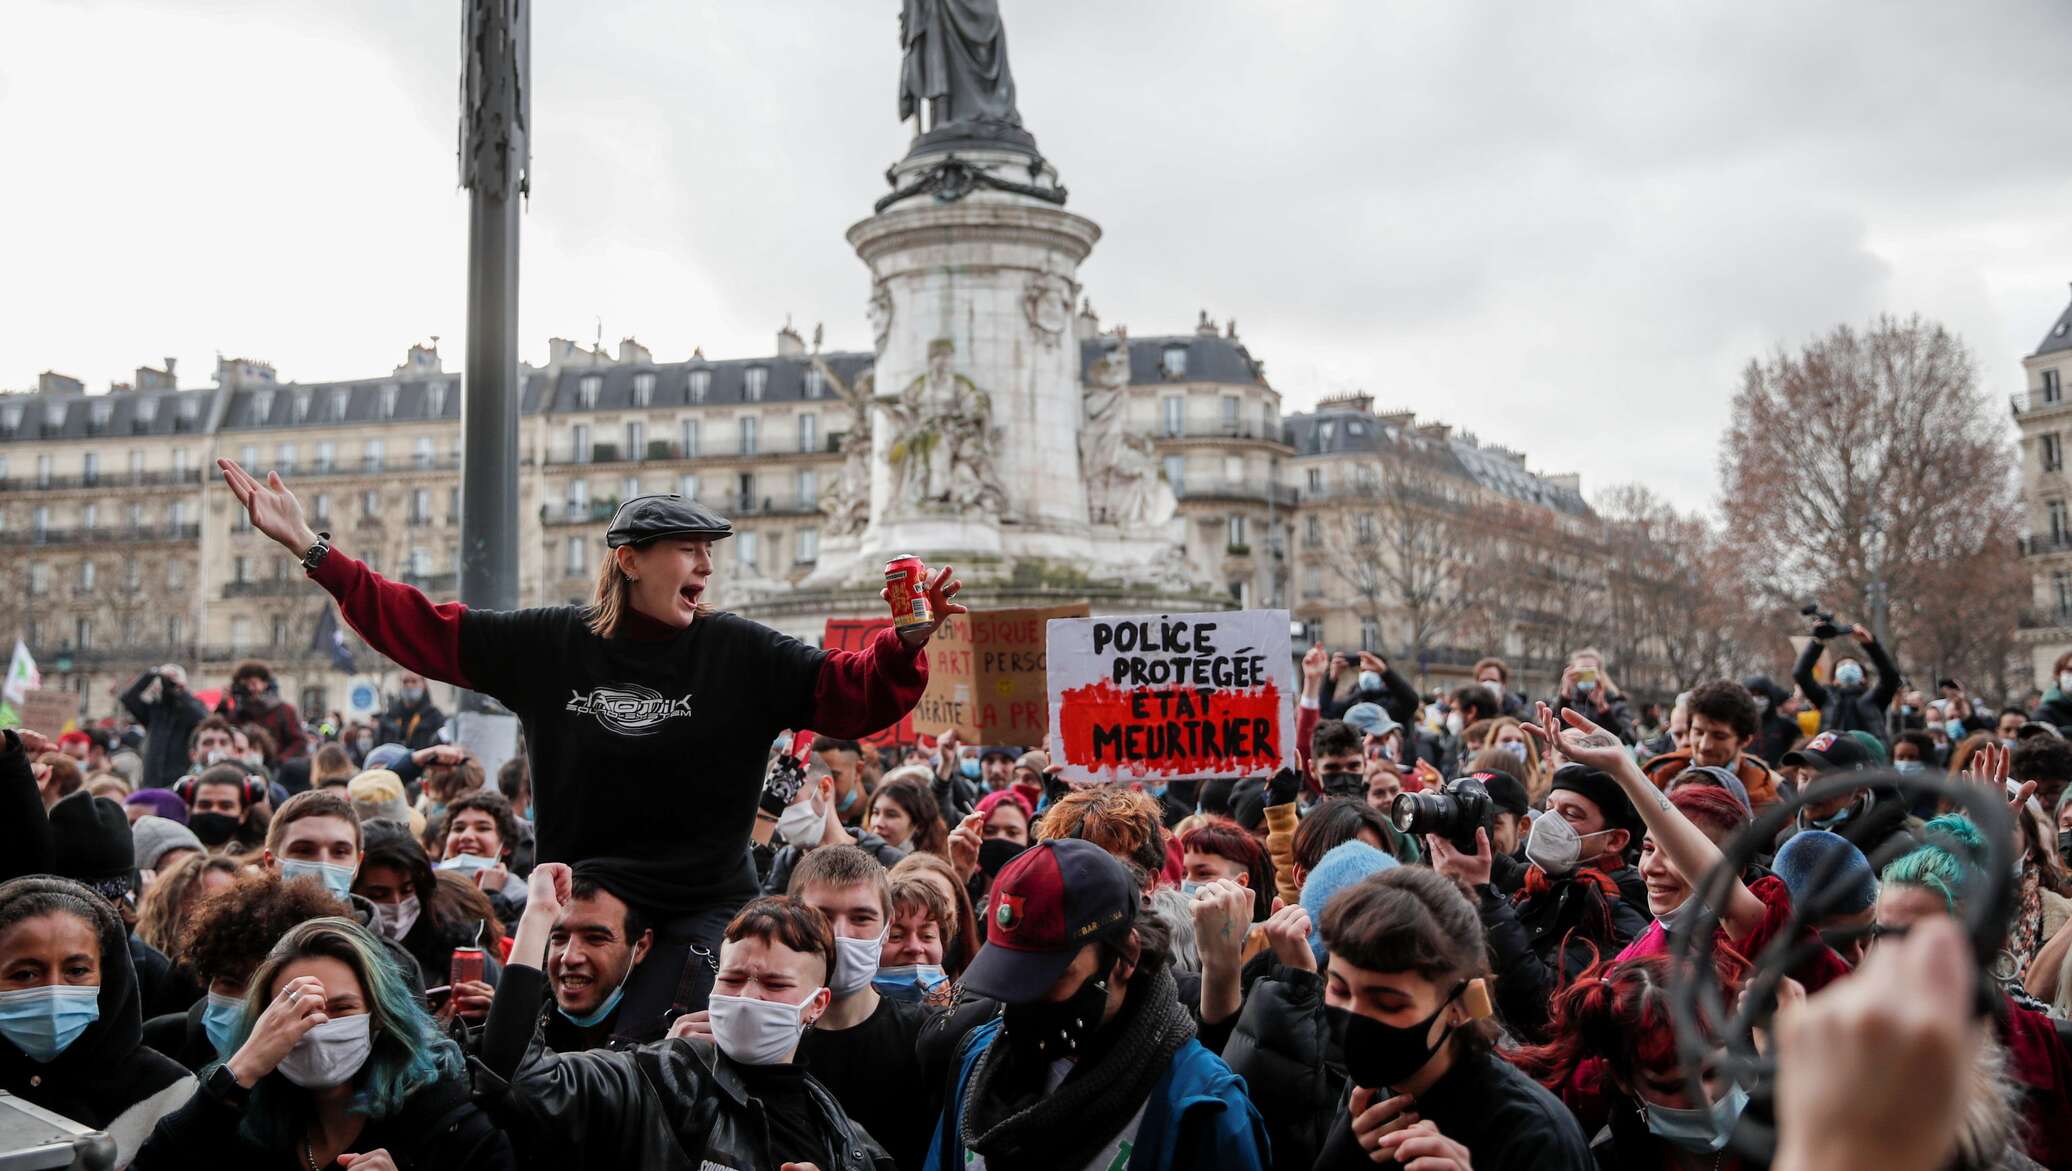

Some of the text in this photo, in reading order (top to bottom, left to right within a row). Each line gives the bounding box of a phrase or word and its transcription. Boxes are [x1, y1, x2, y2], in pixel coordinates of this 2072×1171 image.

[938, 650, 974, 676] ART
[1112, 646, 1268, 687] PROTÉGÉE
[1010, 701, 1049, 731] PR
[1092, 710, 1277, 762] MEURTRIER
